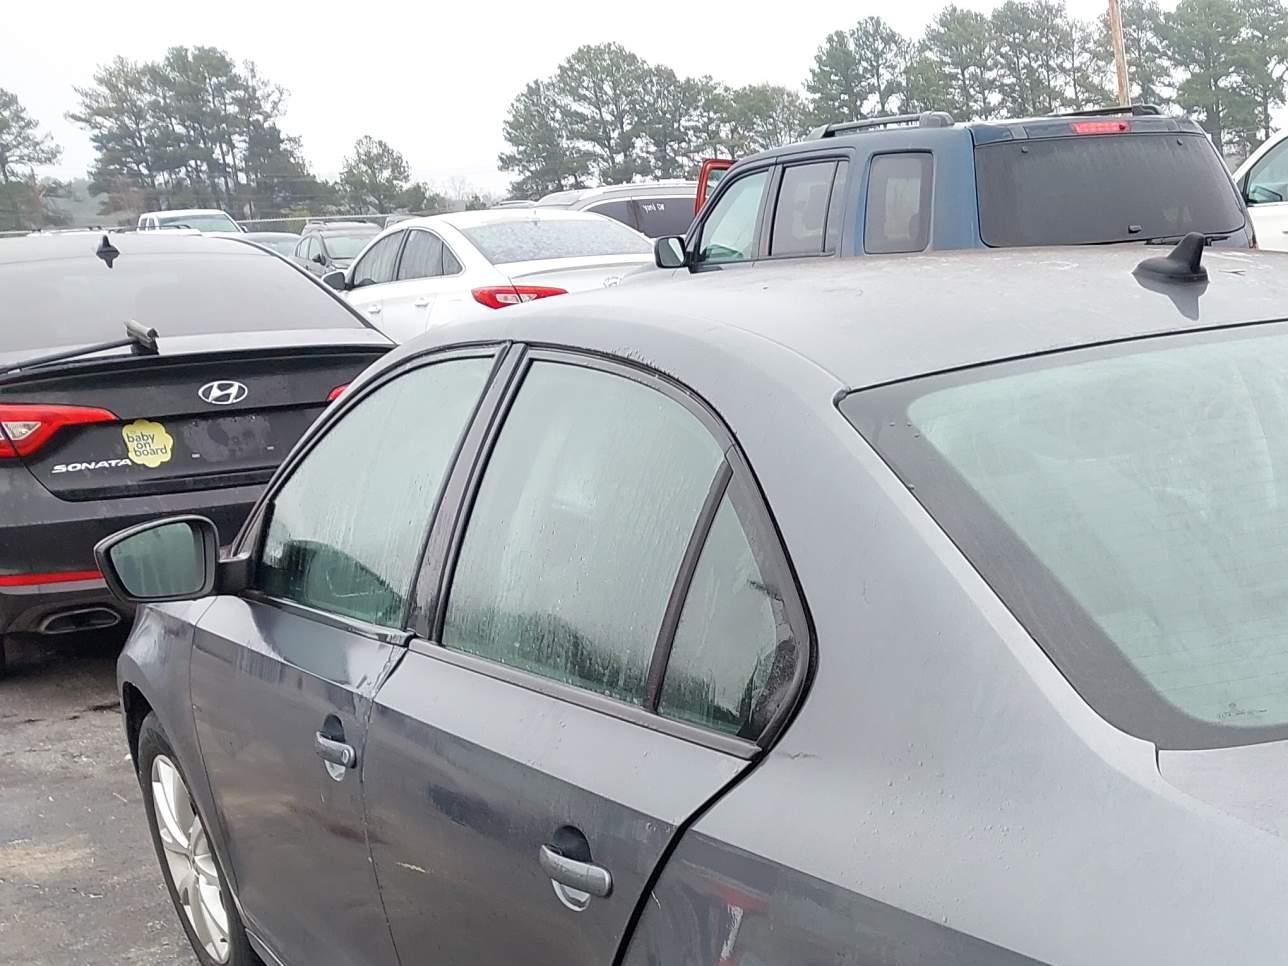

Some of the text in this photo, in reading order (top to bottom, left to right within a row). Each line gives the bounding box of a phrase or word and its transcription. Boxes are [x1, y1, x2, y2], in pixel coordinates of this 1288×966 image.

[126, 431, 155, 444] baby
[134, 444, 168, 457] board
[136, 441, 151, 450] on
[51, 458, 133, 474] SONATA
